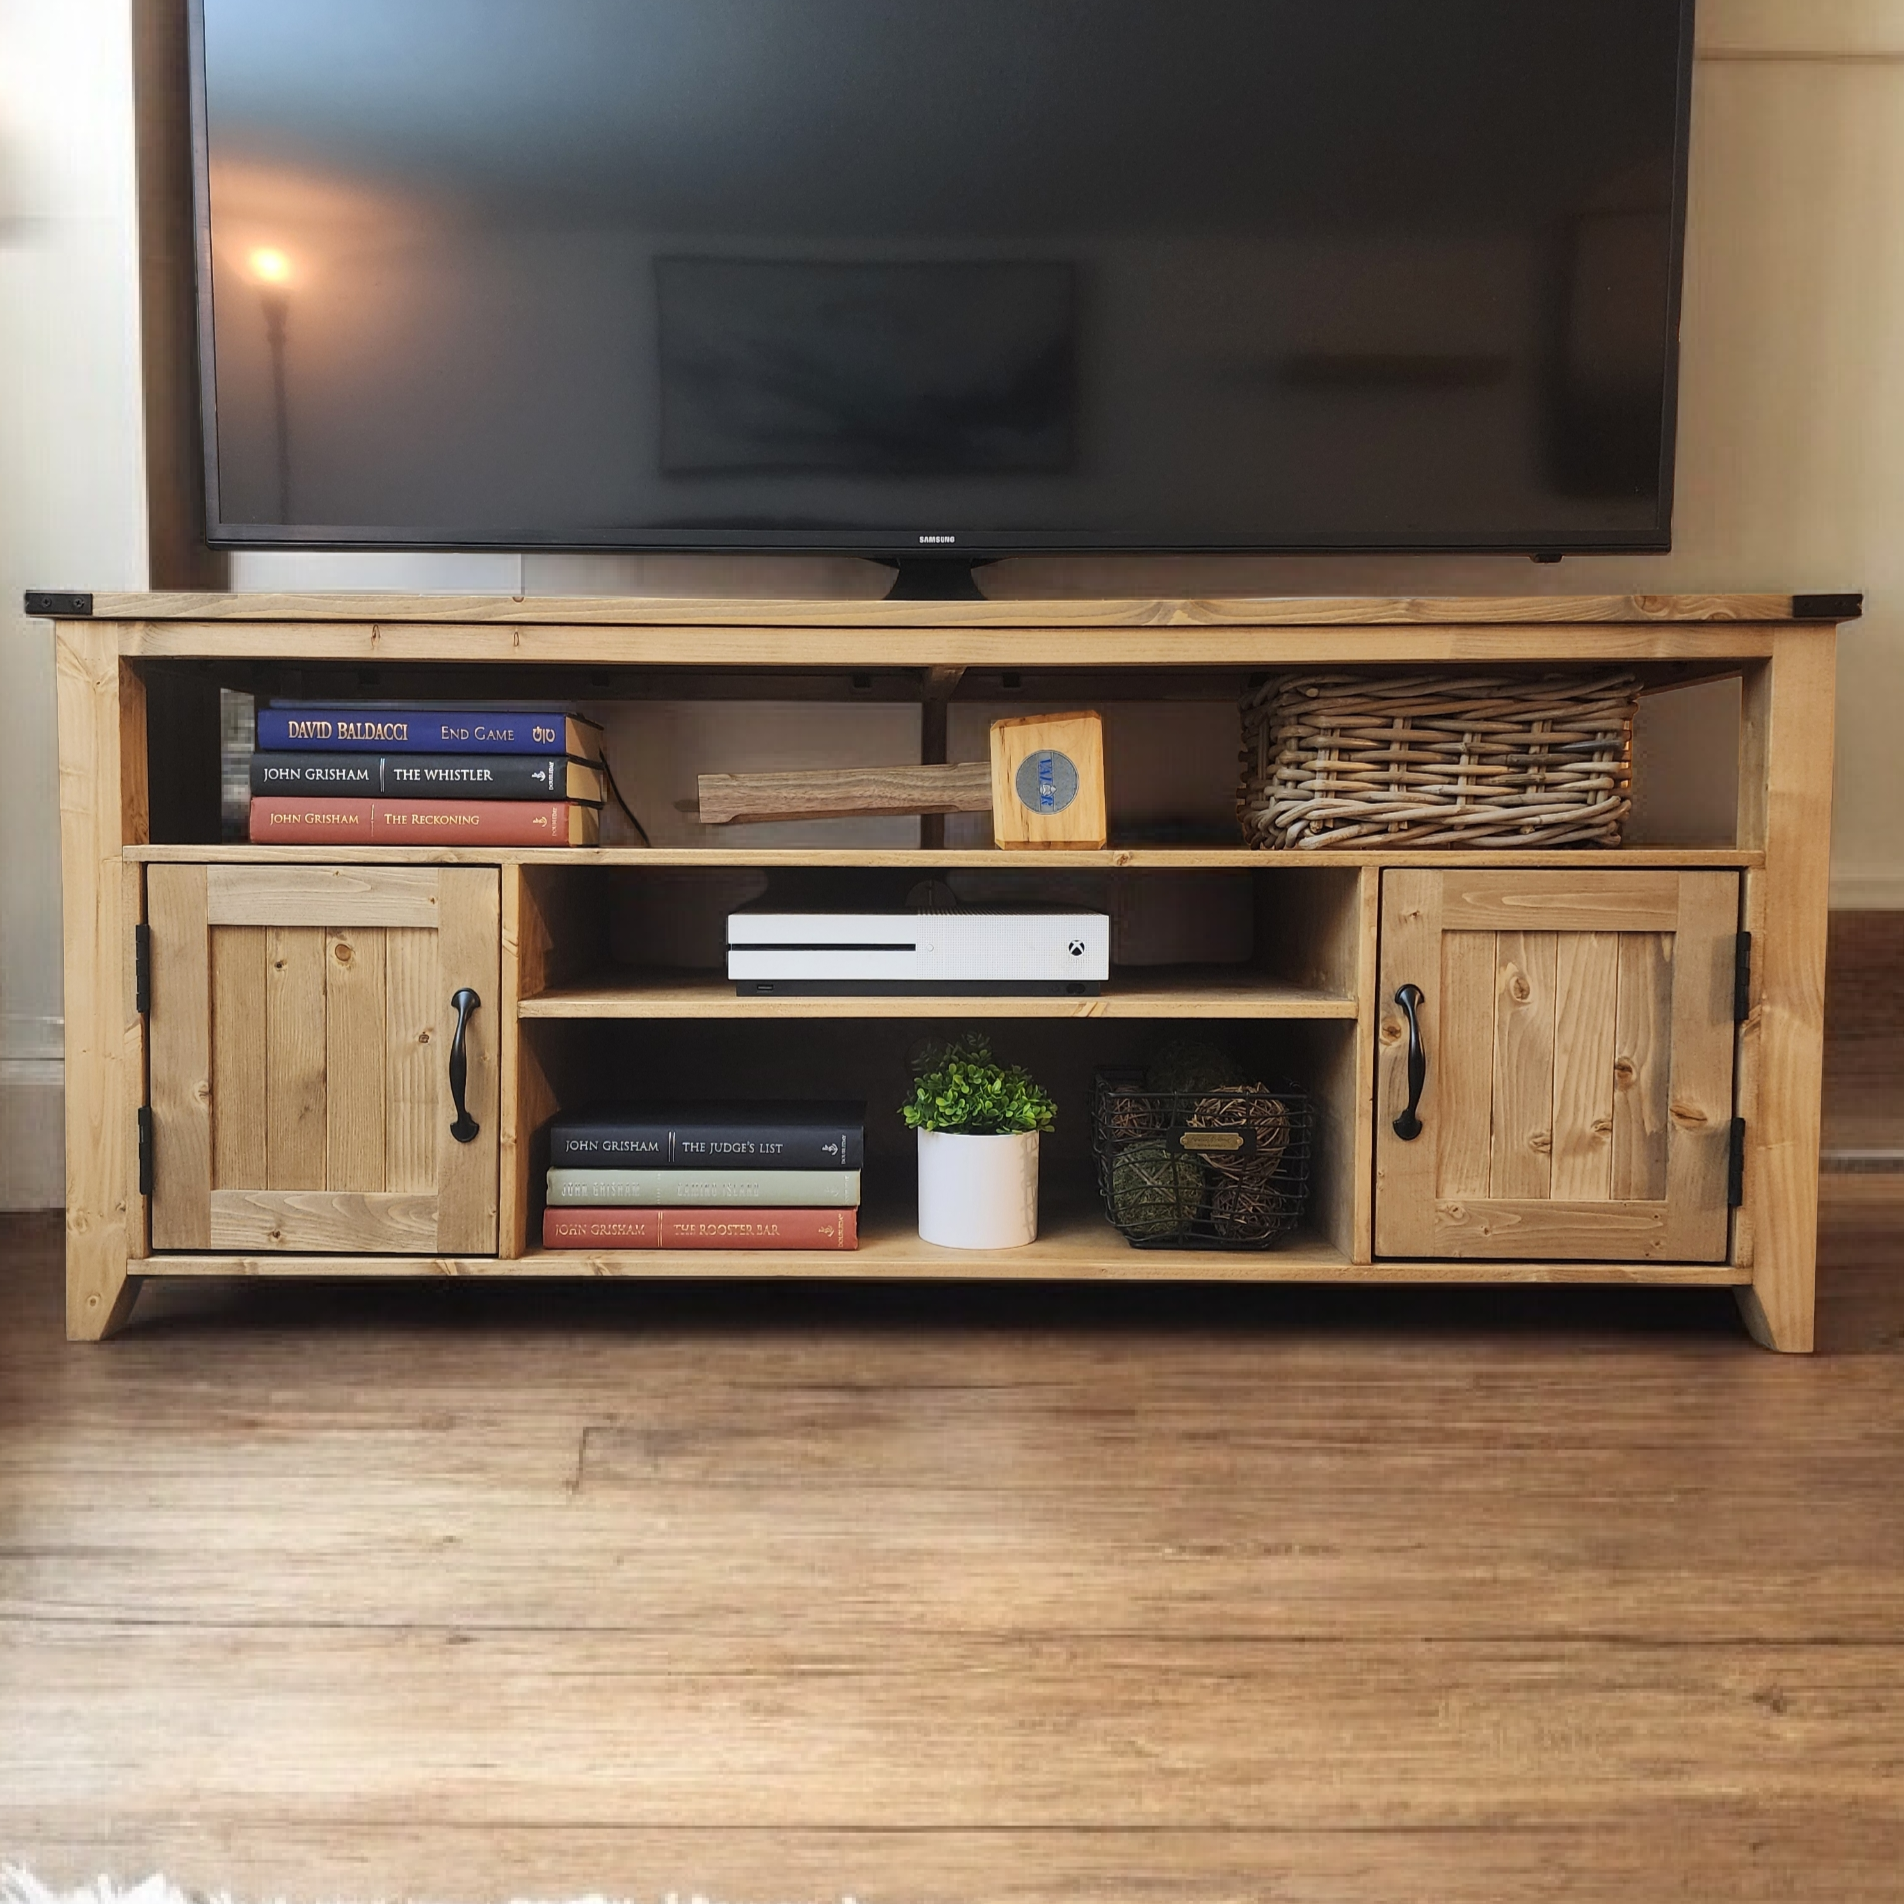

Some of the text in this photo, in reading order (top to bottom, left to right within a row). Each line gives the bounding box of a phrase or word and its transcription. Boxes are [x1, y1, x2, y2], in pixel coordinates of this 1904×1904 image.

[919, 535, 956, 544] SAMSUNG
[288, 720, 409, 742] DAVID BALDACCI
[263, 768, 370, 783] JOHN GRISHAM
[393, 768, 494, 781] THE WHISTLER
[270, 813, 360, 826] JOHN GRISHAM
[384, 813, 480, 826] THE RECKONING
[565, 1140, 660, 1153] JOHN GRISHAM
[682, 1141, 784, 1154] THE JUDGE'S LIST
[555, 1224, 646, 1236] JOHN GRISHAM
[673, 1224, 781, 1237] THE ROOSTER BAR
